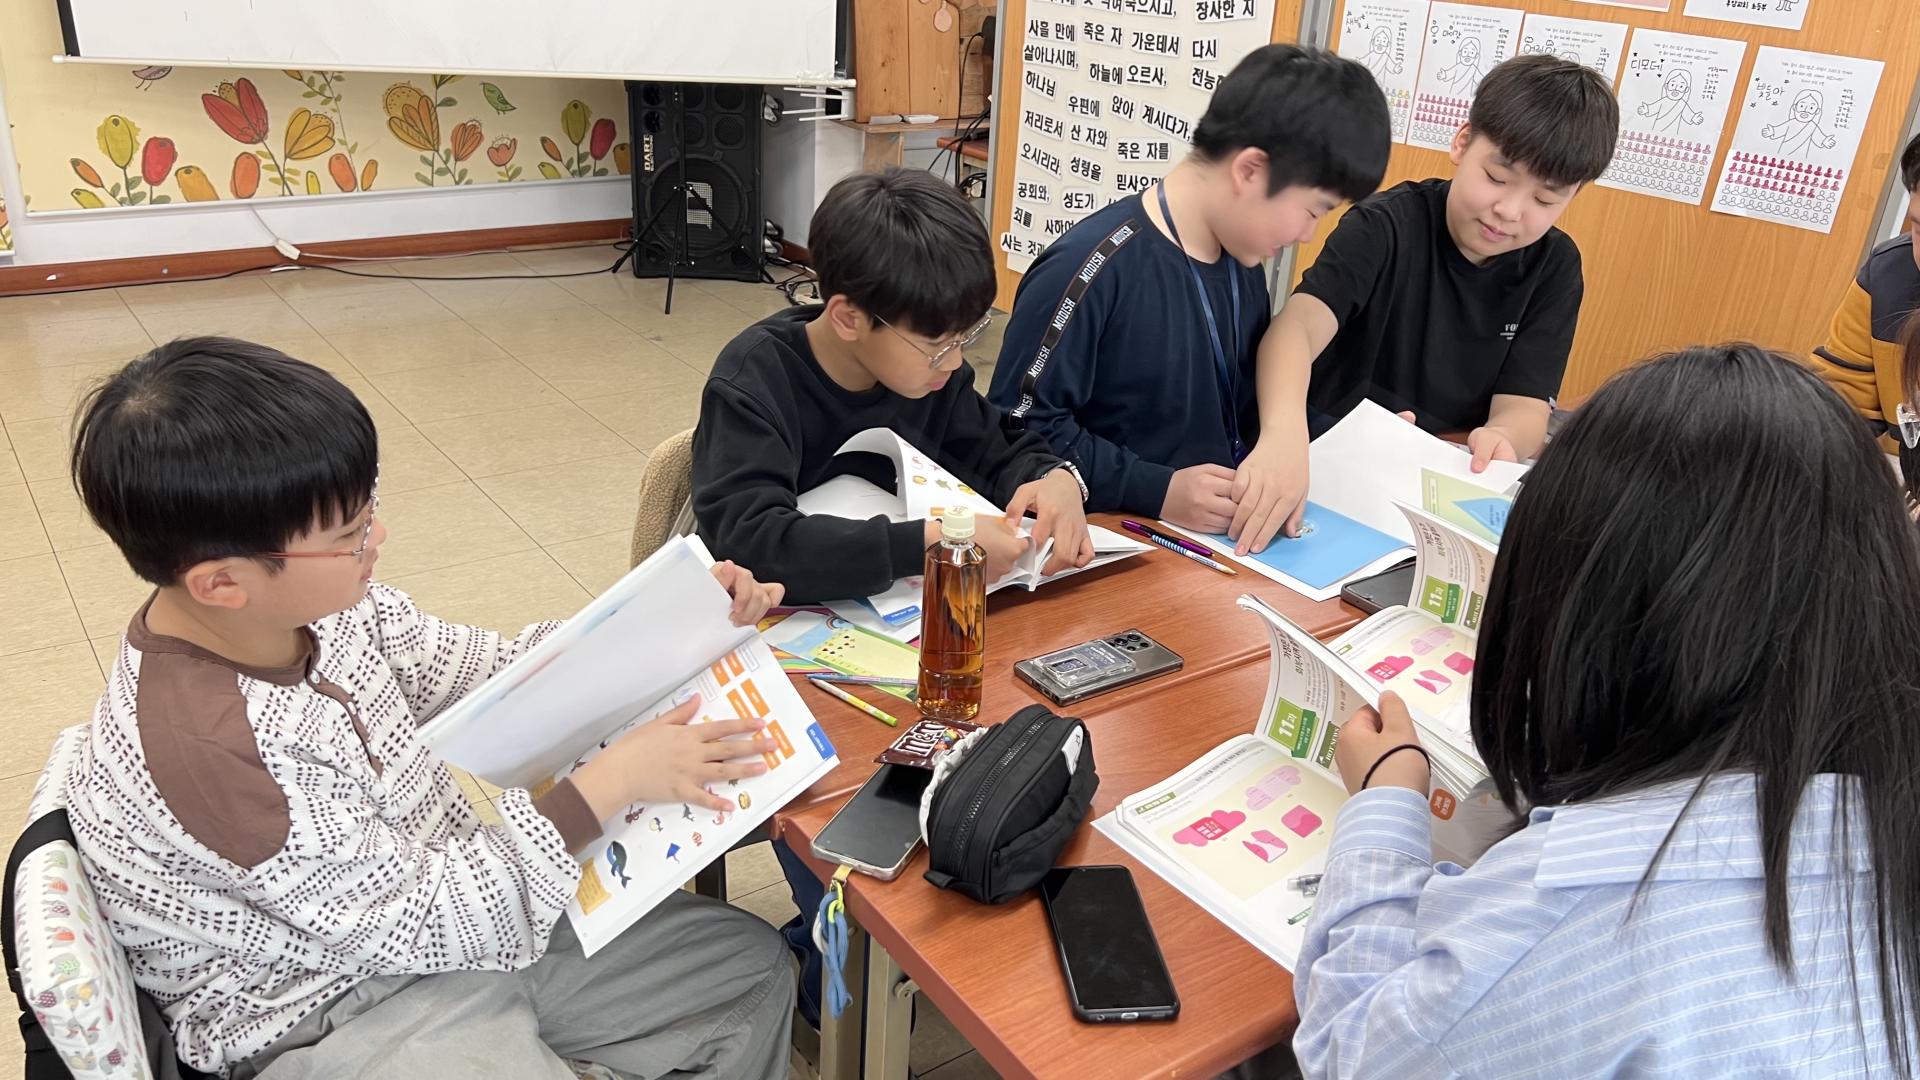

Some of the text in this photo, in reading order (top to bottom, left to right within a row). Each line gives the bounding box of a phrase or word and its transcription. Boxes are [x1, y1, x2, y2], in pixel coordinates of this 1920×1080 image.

[1196, 0, 1235, 21] 장사한
[1028, 19, 1049, 38] 사흘
[1055, 22, 1075, 42] 만에
[1083, 22, 1105, 42] 죽은
[1110, 27, 1122, 45] 자
[1192, 39, 1217, 59] 다시
[1024, 44, 1079, 69] 살아나시며,
[1089, 63, 1123, 85] 하늘에
[1126, 64, 1167, 86] 오르사,
[1631, 59, 1663, 71] 디모데
[1026, 71, 1191, 142] 하나님 우편에 앉아 계시다가,
[1024, 110, 1169, 160] 저리로서 산 자와 죽은 자를
[643, 135, 651, 171] DART
[1020, 142, 1062, 176] 오시리라.
[1070, 156, 1102, 182] 성령을
[1018, 182, 1049, 202] 공회와,
[1063, 192, 1094, 209] 성도가
[1013, 206, 1032, 228] 죄를
[1001, 233, 1022, 252] 사는
[1079, 251, 1106, 284] MODISH
[1052, 297, 1076, 331] MODISH
[1027, 345, 1051, 378] MODISH
[1012, 393, 1034, 418] MODISH
[1278, 712, 1297, 737] 11과
